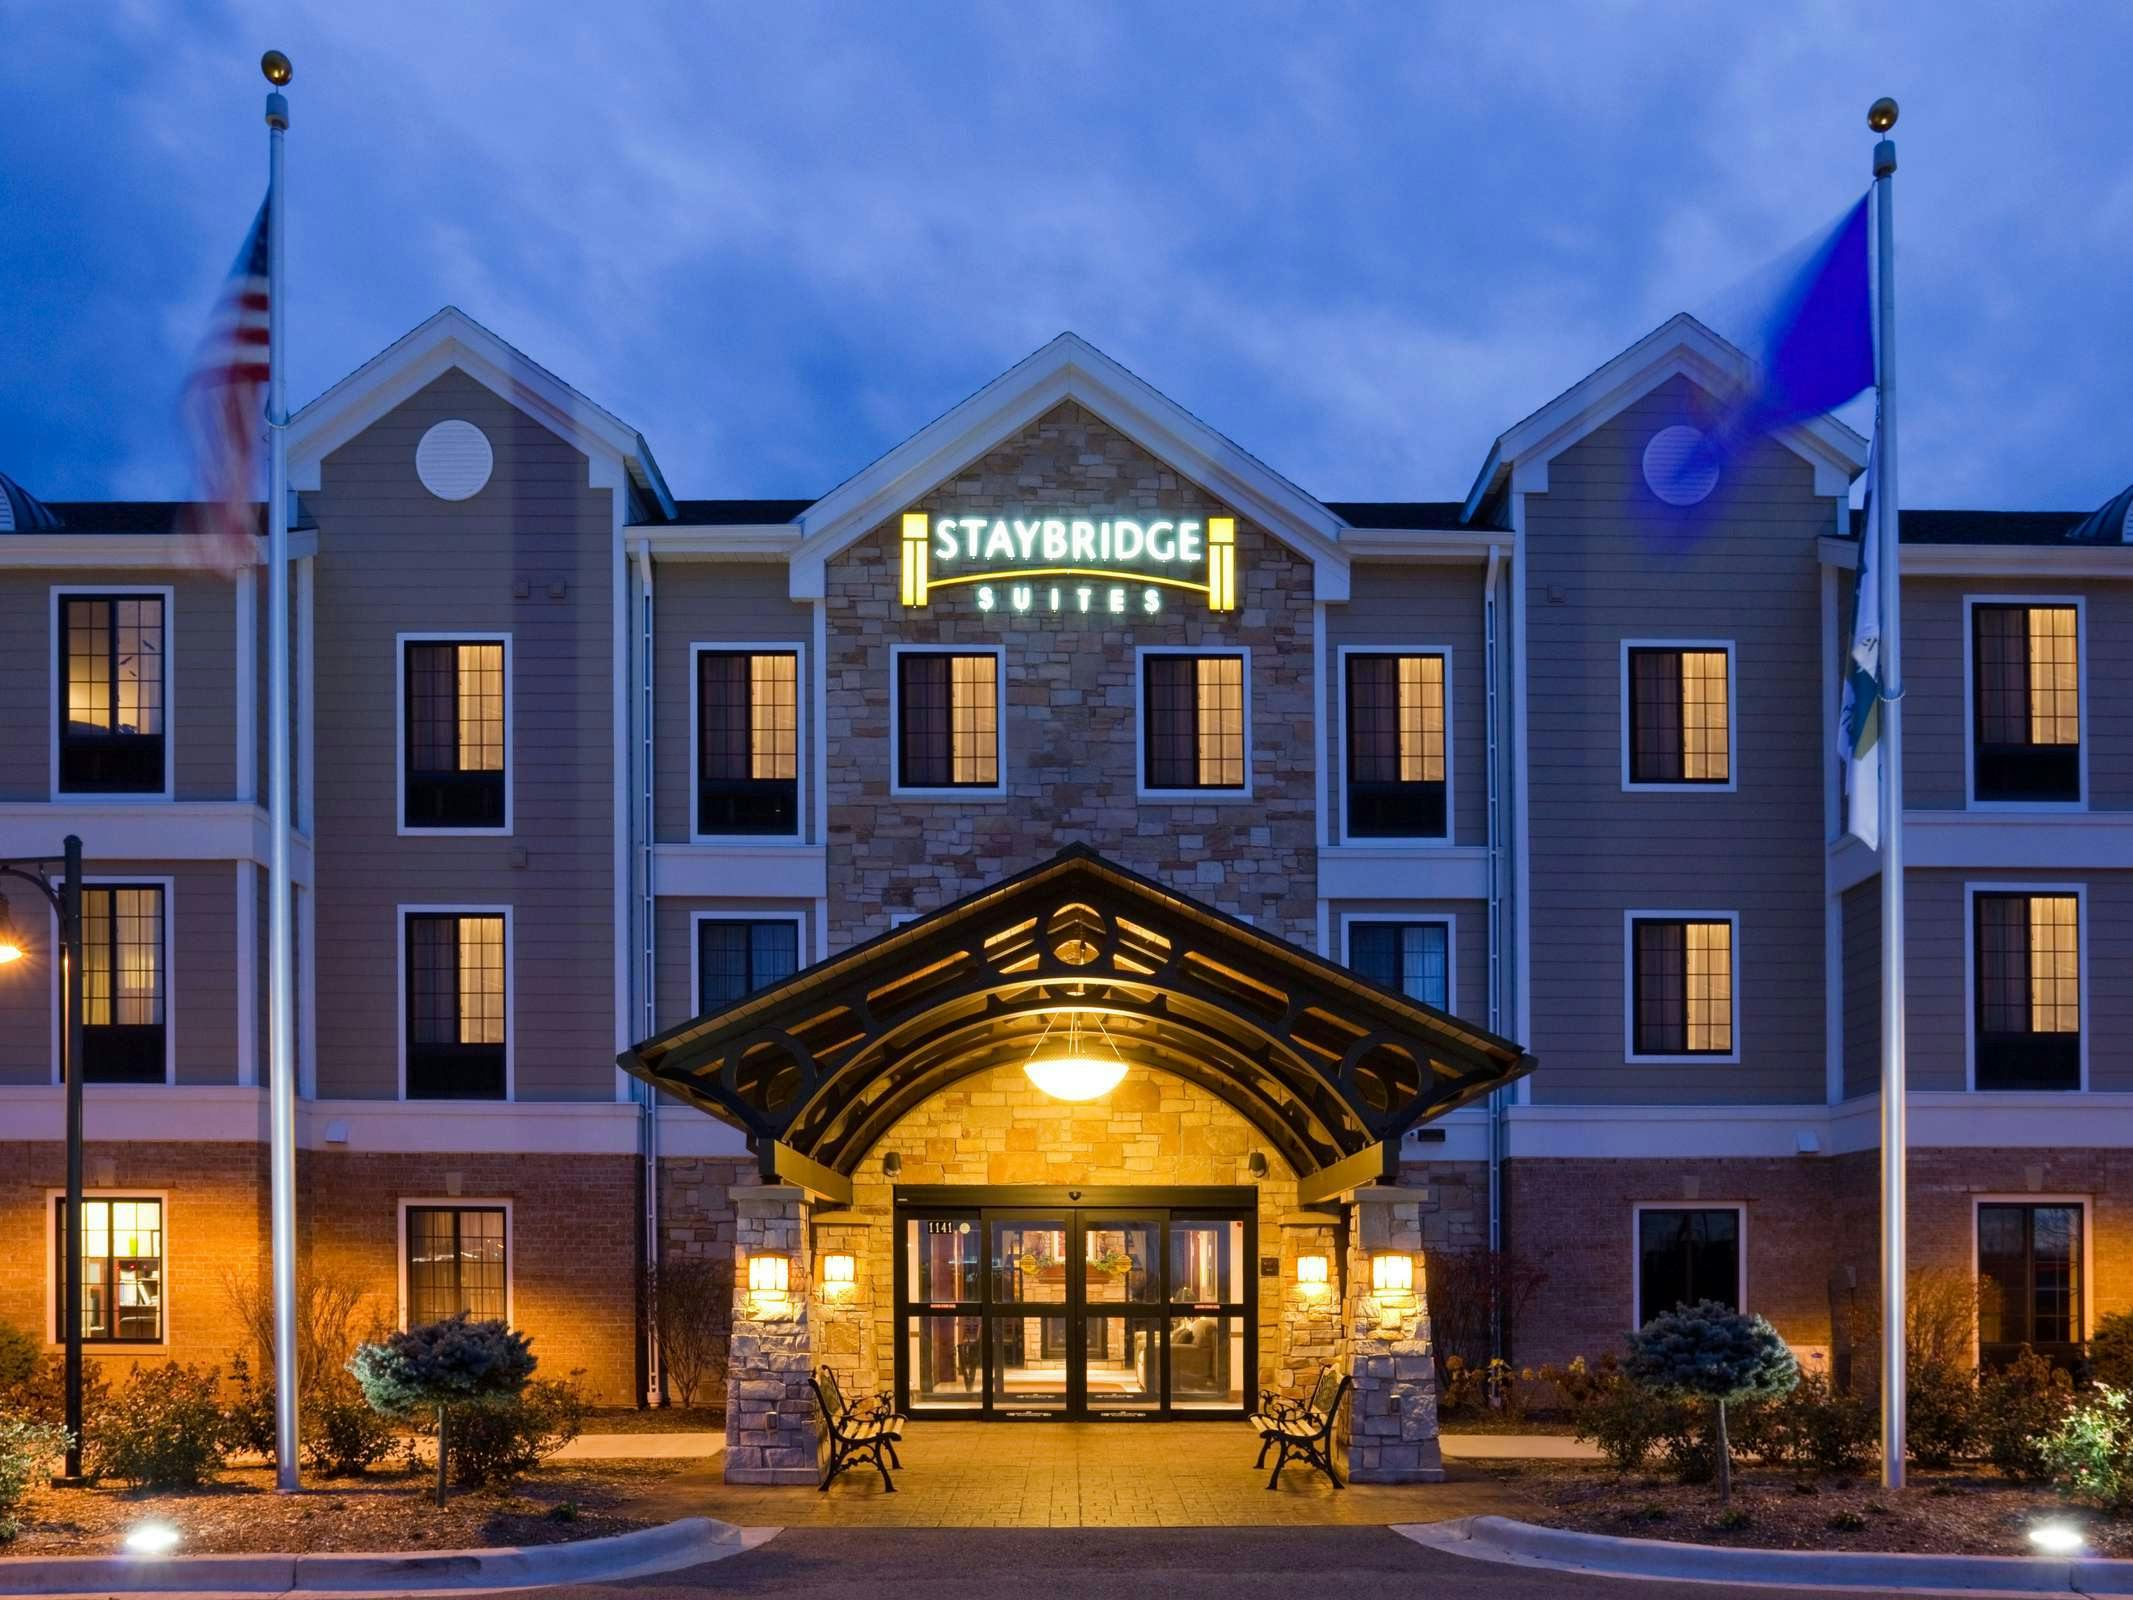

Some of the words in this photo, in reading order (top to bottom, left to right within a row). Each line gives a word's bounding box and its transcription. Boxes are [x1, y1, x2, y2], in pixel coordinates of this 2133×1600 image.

[935, 519, 1202, 561] STAYBRIDGE
[978, 586, 1161, 612] SUITES
[929, 1221, 953, 1233] 1141
